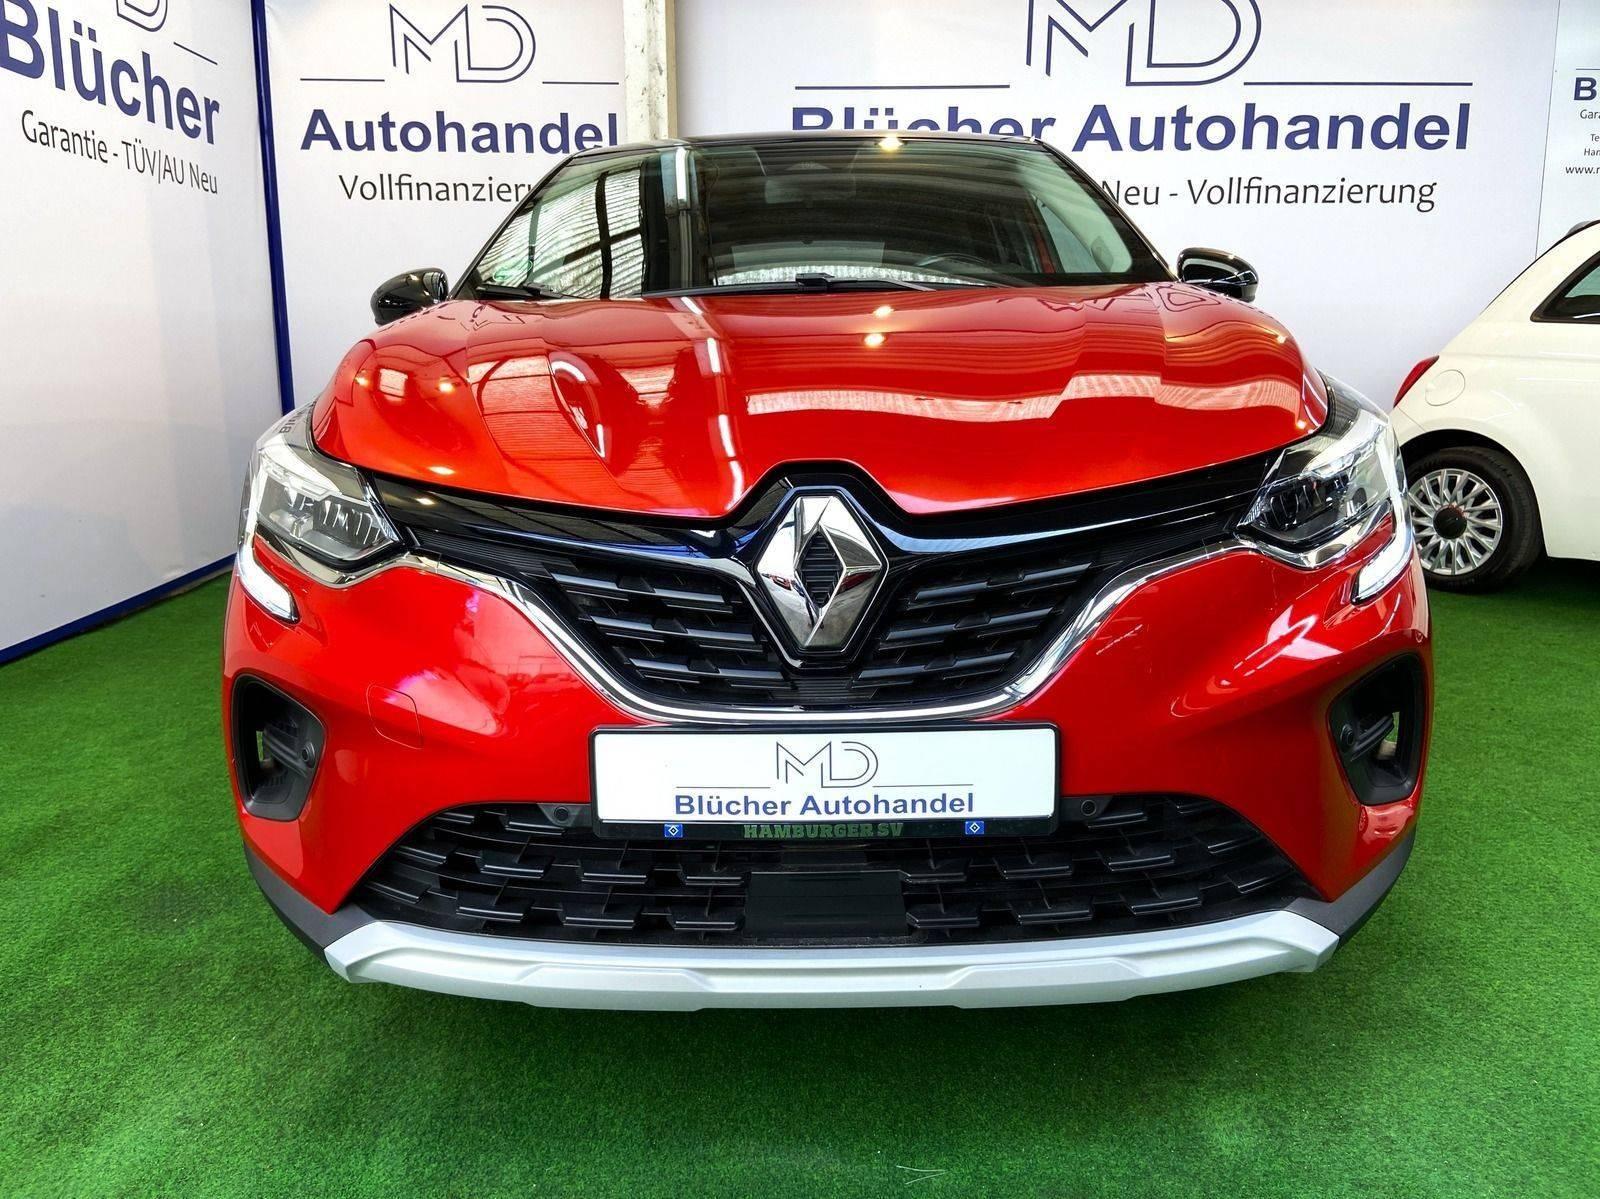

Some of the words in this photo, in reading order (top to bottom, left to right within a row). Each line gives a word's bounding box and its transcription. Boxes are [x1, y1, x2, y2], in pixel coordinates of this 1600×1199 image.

[0, 0, 220, 145] Blücher
[300, 109, 618, 154] Autohandel
[1071, 102, 1471, 152] Autohandel
[21, 109, 109, 164] Garantie
[189, 162, 218, 195] Neu
[1101, 180, 1160, 206] Neu
[1187, 176, 1438, 213] Vollfinanzierung
[675, 795, 792, 816] Blücher
[800, 793, 974, 815] Autohandel
[743, 823, 874, 839] HAMBURGER
[877, 822, 904, 837] SV
